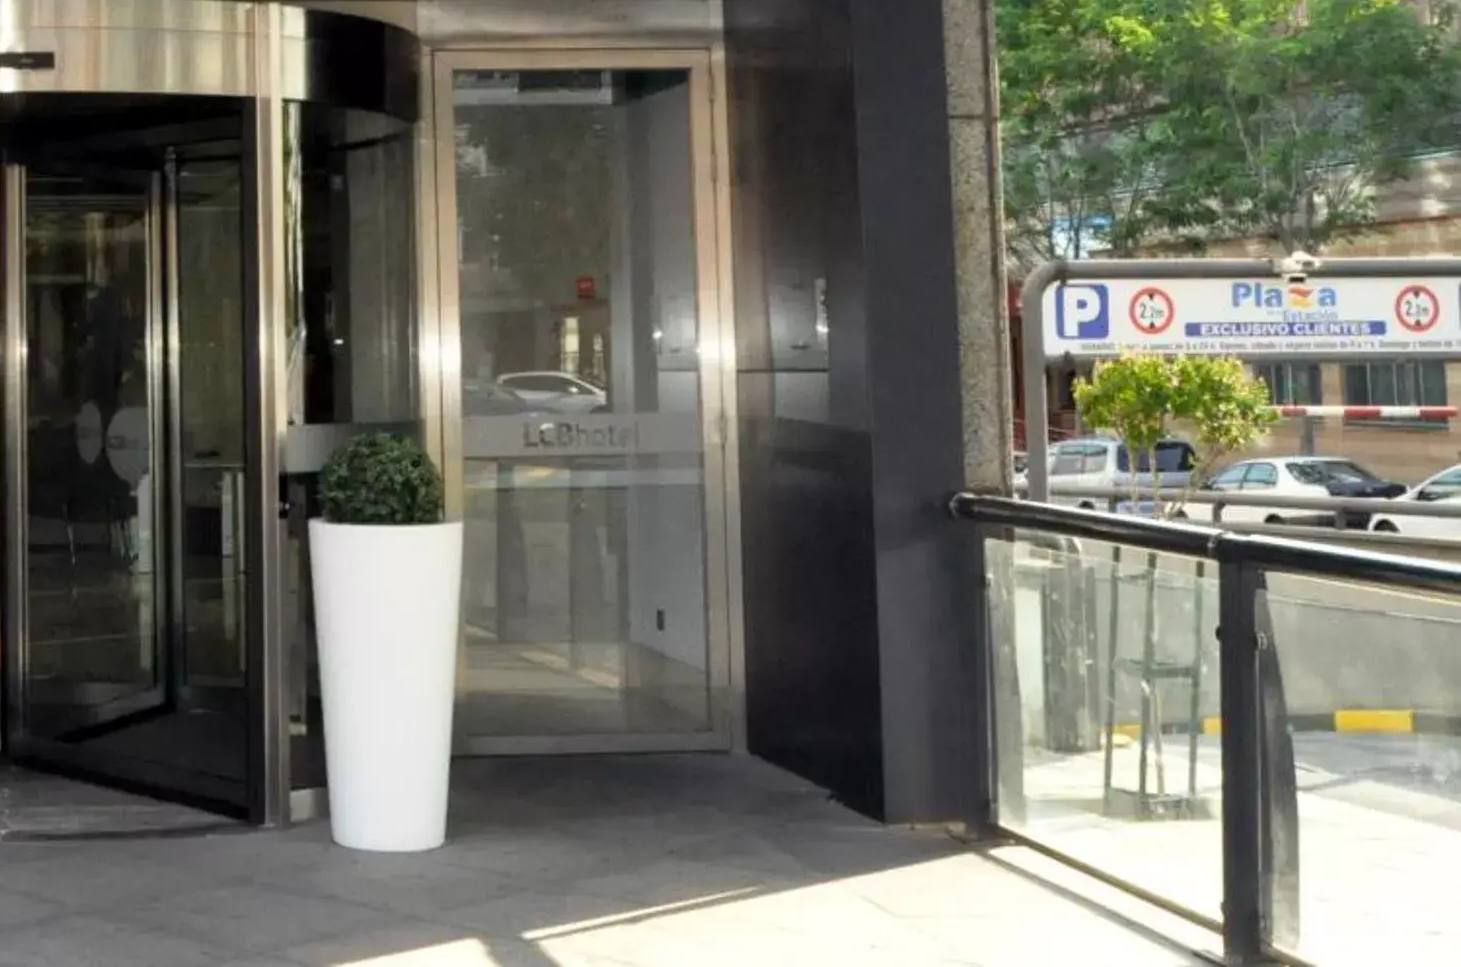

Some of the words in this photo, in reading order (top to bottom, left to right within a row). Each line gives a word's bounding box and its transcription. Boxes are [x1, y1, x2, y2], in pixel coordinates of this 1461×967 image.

[1063, 286, 1101, 336] P
[1200, 323, 1288, 335] EXCLUSIVO
[1292, 322, 1371, 334] CLIENTES
